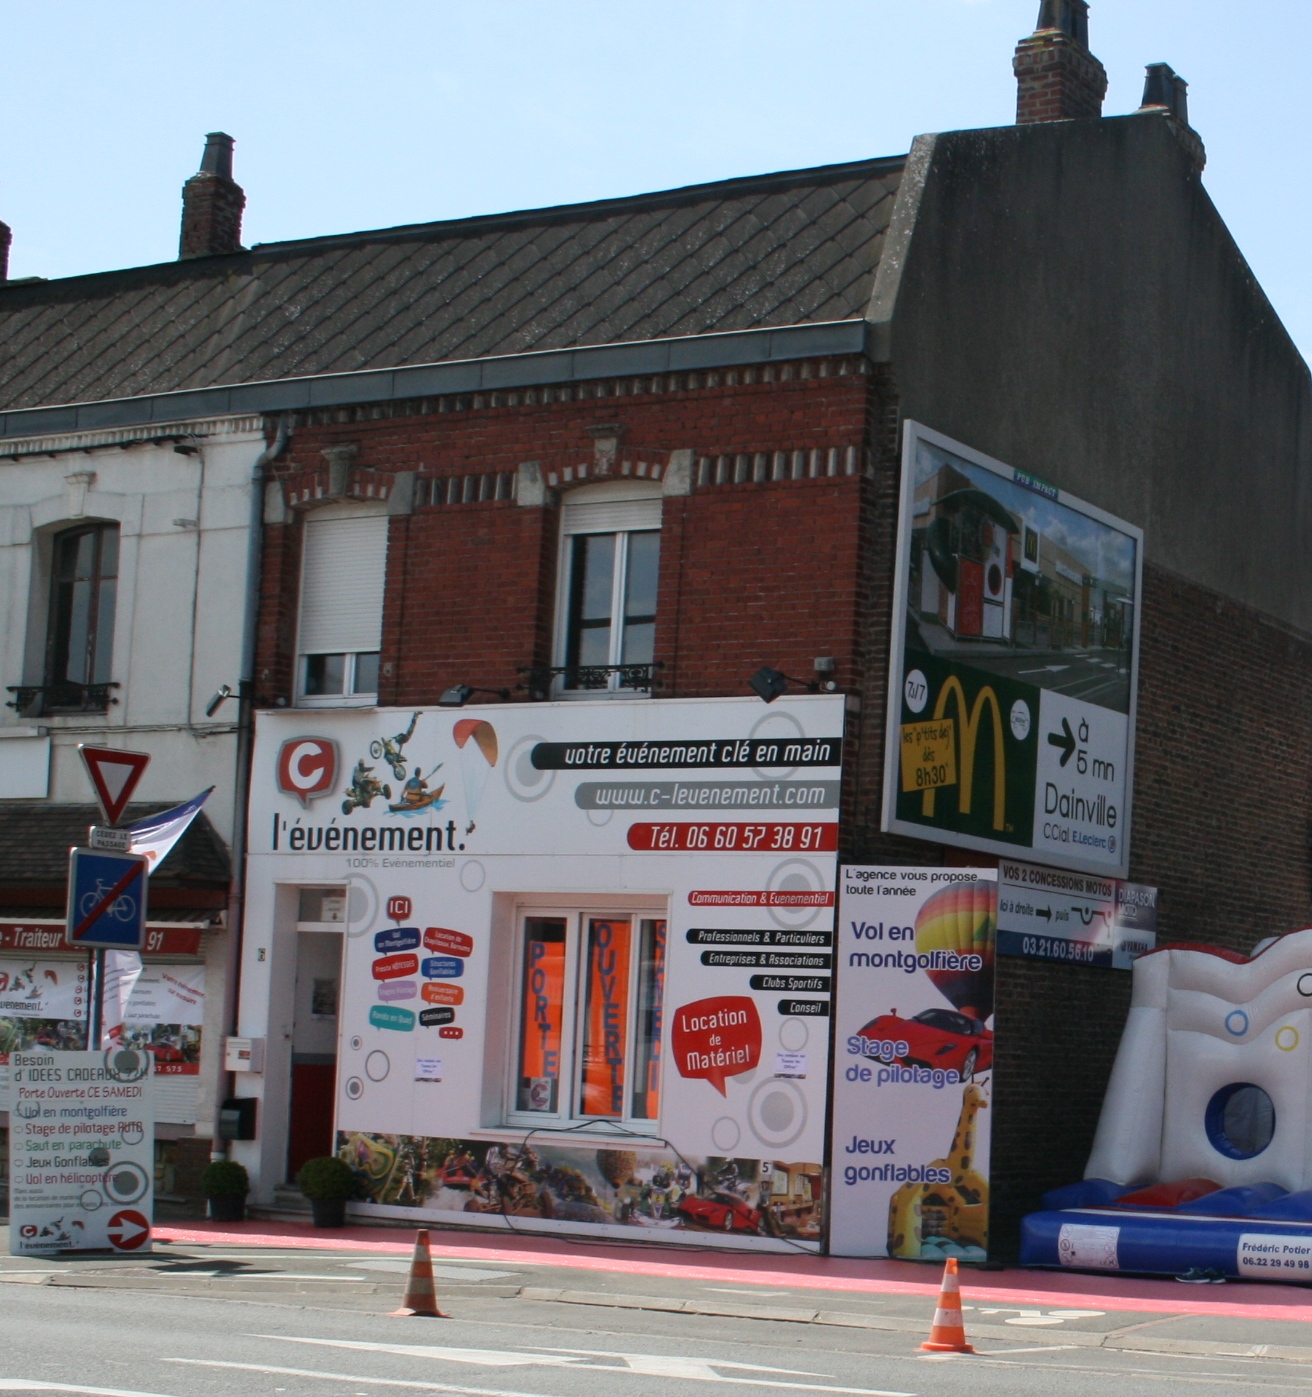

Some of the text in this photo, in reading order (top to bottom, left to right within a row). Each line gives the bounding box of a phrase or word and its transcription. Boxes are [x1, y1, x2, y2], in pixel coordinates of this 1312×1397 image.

[1078, 717, 1090, 744] à
[721, 740, 750, 763] clé
[756, 744, 778, 762] en
[783, 740, 831, 762] main
[1076, 750, 1115, 782] 5 mn
[595, 783, 826, 805] www.c-levenement.com
[1044, 782, 1117, 828] Dainville
[272, 812, 466, 851] l'événement.
[650, 826, 824, 849] Tél. 06 60 57 38 91
[97, 839, 126, 848] PASSAGE
[1072, 830, 1107, 849] E.Leclerc
[346, 858, 379, 868] 100%
[900, 873, 928, 881] vous
[930, 872, 978, 883] propose
[1003, 864, 1112, 897] VOS 2 CONCESSIONS MOTOS
[845, 885, 874, 895] toute
[691, 892, 829, 905] Communication & Evenementiel
[389, 900, 409, 914] ICI
[1009, 901, 1014, 913] à
[1015, 901, 1035, 917] droite
[1055, 910, 1069, 922] puis
[435, 931, 455, 942] Location
[698, 930, 825, 944] Professionnels & Particuliers
[851, 921, 914, 941] Vol en
[14, 928, 163, 950] Traiteur 91
[430, 960, 456, 968] Structures
[709, 953, 824, 966] Entreprises & Associations
[849, 949, 982, 974] montgolfière
[762, 977, 823, 990] Clubs Sportifs
[789, 1002, 822, 1014] Conseil
[421, 1010, 452, 1021] Séminaires
[682, 1009, 747, 1033] Location
[709, 1034, 722, 1047] de
[846, 1036, 908, 1060] Stage
[14, 1054, 54, 1066] Besoin
[686, 1044, 750, 1071] Matériel
[845, 1064, 960, 1089] de pilotage
[19, 1086, 142, 1099] Porte Ouverte CE SAMEDI
[43, 1109, 56, 1118] en
[60, 1105, 128, 1120] montgolfière
[25, 1123, 56, 1137] Stage
[58, 1123, 71, 1134] de
[73, 1123, 115, 1136] pilotage
[25, 1139, 122, 1153] Saut en parachute
[845, 1135, 896, 1154] Jeux
[26, 1156, 110, 1168] Jeux Gonflables
[45, 1175, 58, 1184] en
[60, 1172, 119, 1185] hélicoptère
[844, 1163, 951, 1186] gonflables
[1242, 1242, 1311, 1255] Frédéric Potier
[1242, 1256, 1309, 1269] 06.22 29 49 98
